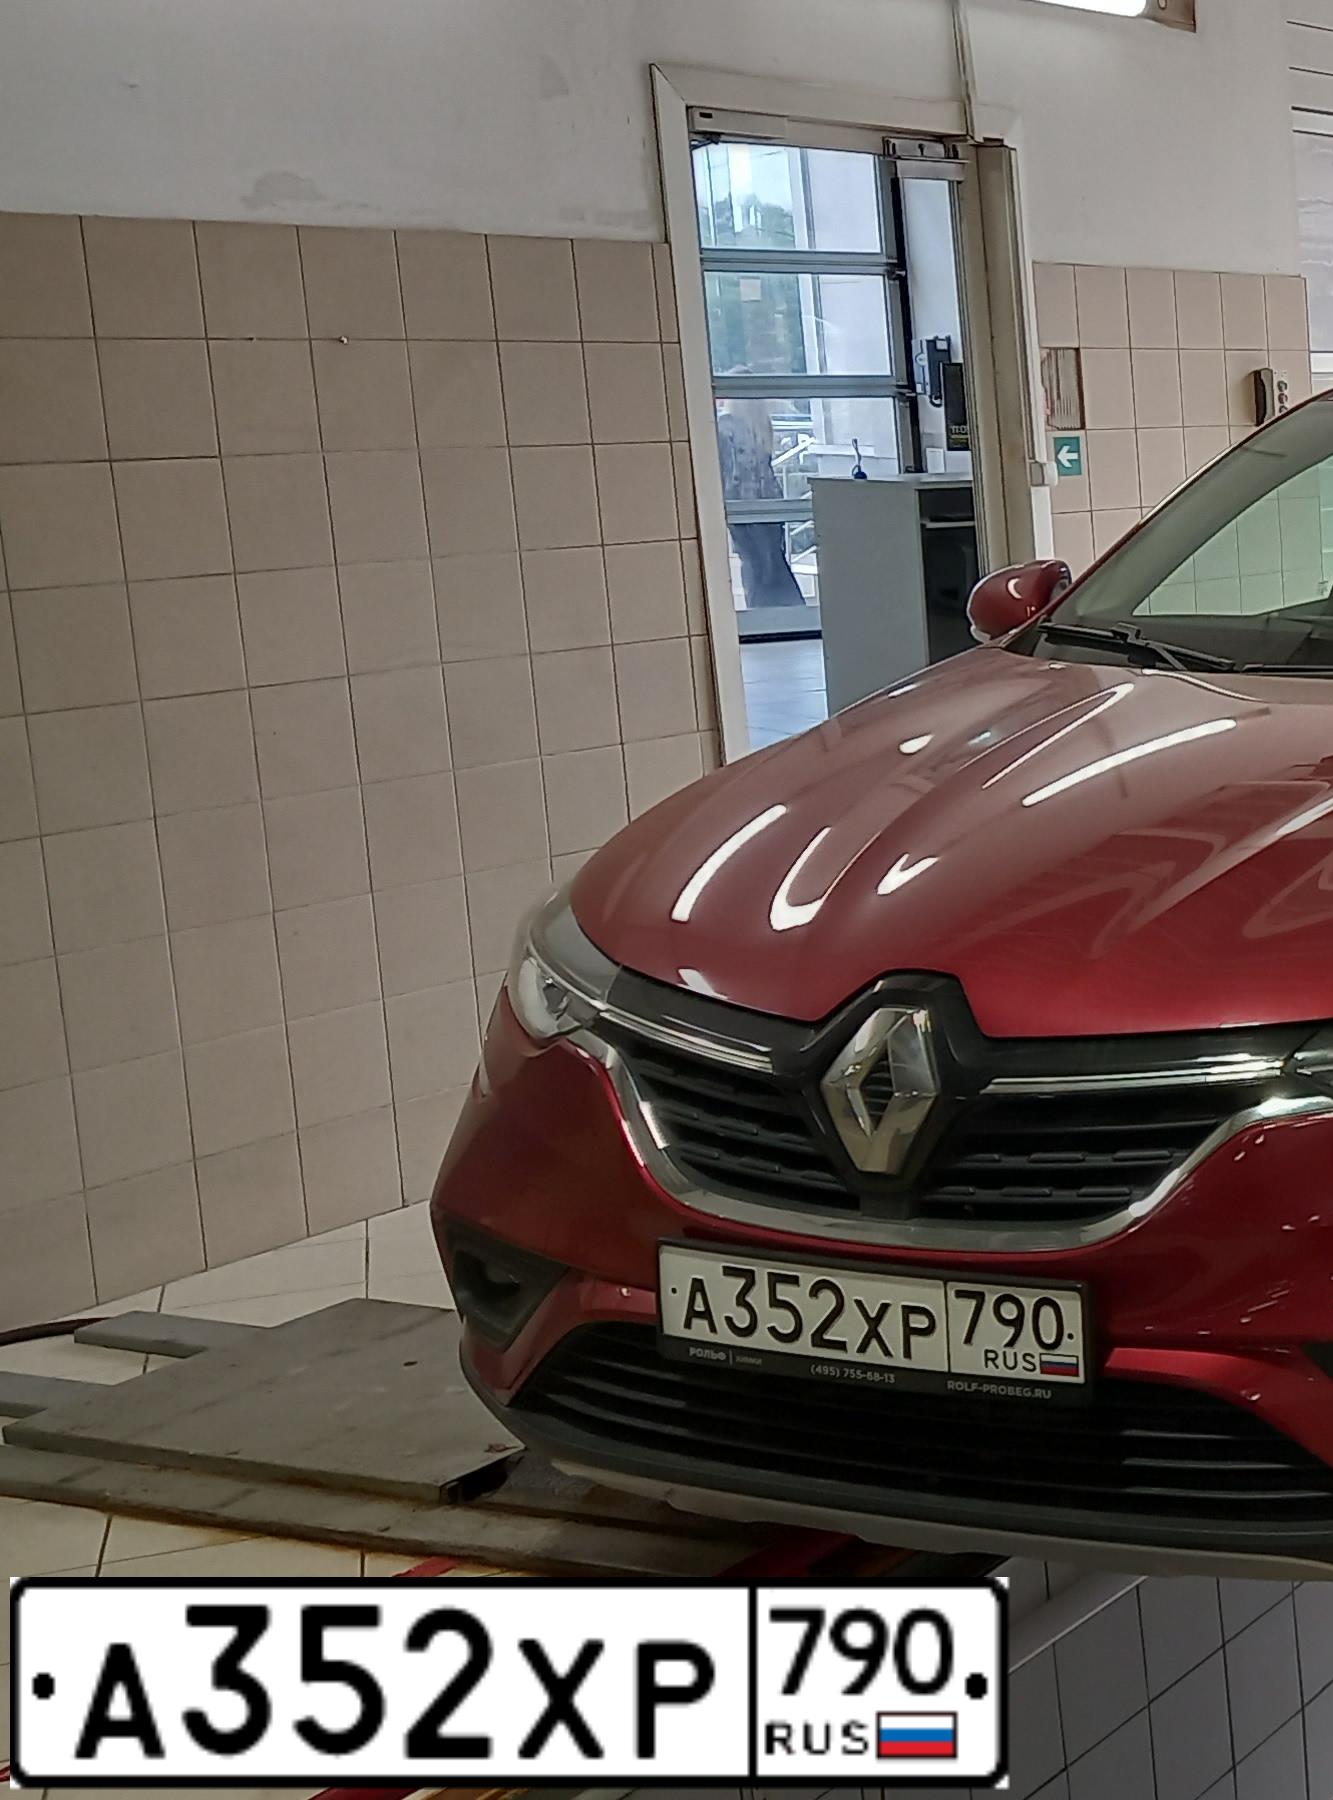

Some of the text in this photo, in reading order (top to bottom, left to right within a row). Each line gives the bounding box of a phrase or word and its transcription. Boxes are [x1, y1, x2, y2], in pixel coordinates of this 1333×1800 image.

[683, 1265, 1066, 1361] А352ХР 790
[689, 1347, 727, 1361] РОЛЬФ
[984, 1348, 1037, 1374] RUS
[810, 1364, 896, 1385] (495) 755-68-13
[947, 1379, 1052, 1399] ROLF-PROBEG.RU
